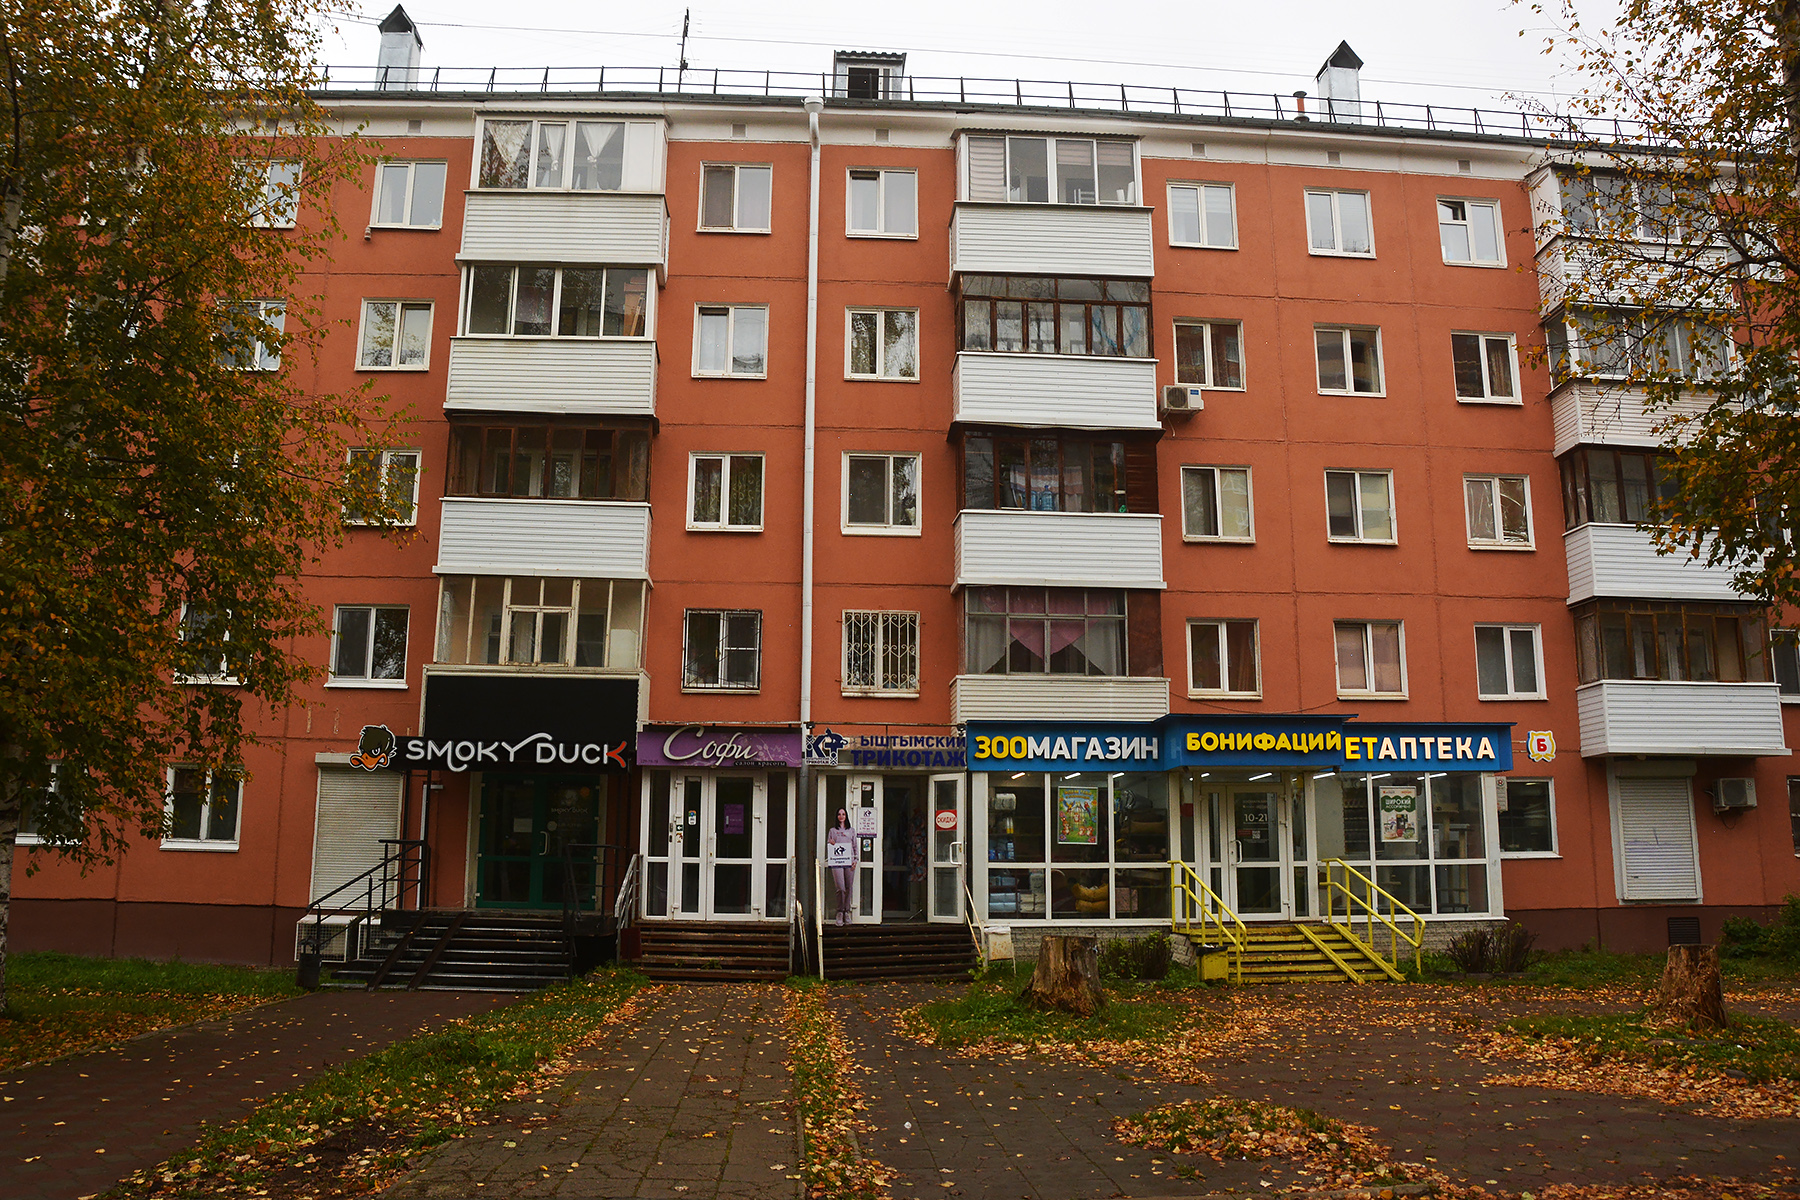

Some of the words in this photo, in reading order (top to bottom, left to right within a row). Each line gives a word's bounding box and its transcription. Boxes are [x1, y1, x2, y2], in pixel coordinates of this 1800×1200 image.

[405, 732, 552, 772] SMOKY
[536, 740, 627, 768] DUCK
[663, 724, 758, 767] Софи
[974, 735, 1159, 760] ЗООМАГАЗИН
[1186, 730, 1342, 754] БОНИФАЦИЙ
[1536, 738, 1548, 753] Б
[850, 750, 967, 767] ТРИКОТАЖ
[1244, 813, 1268, 822] 10-21
